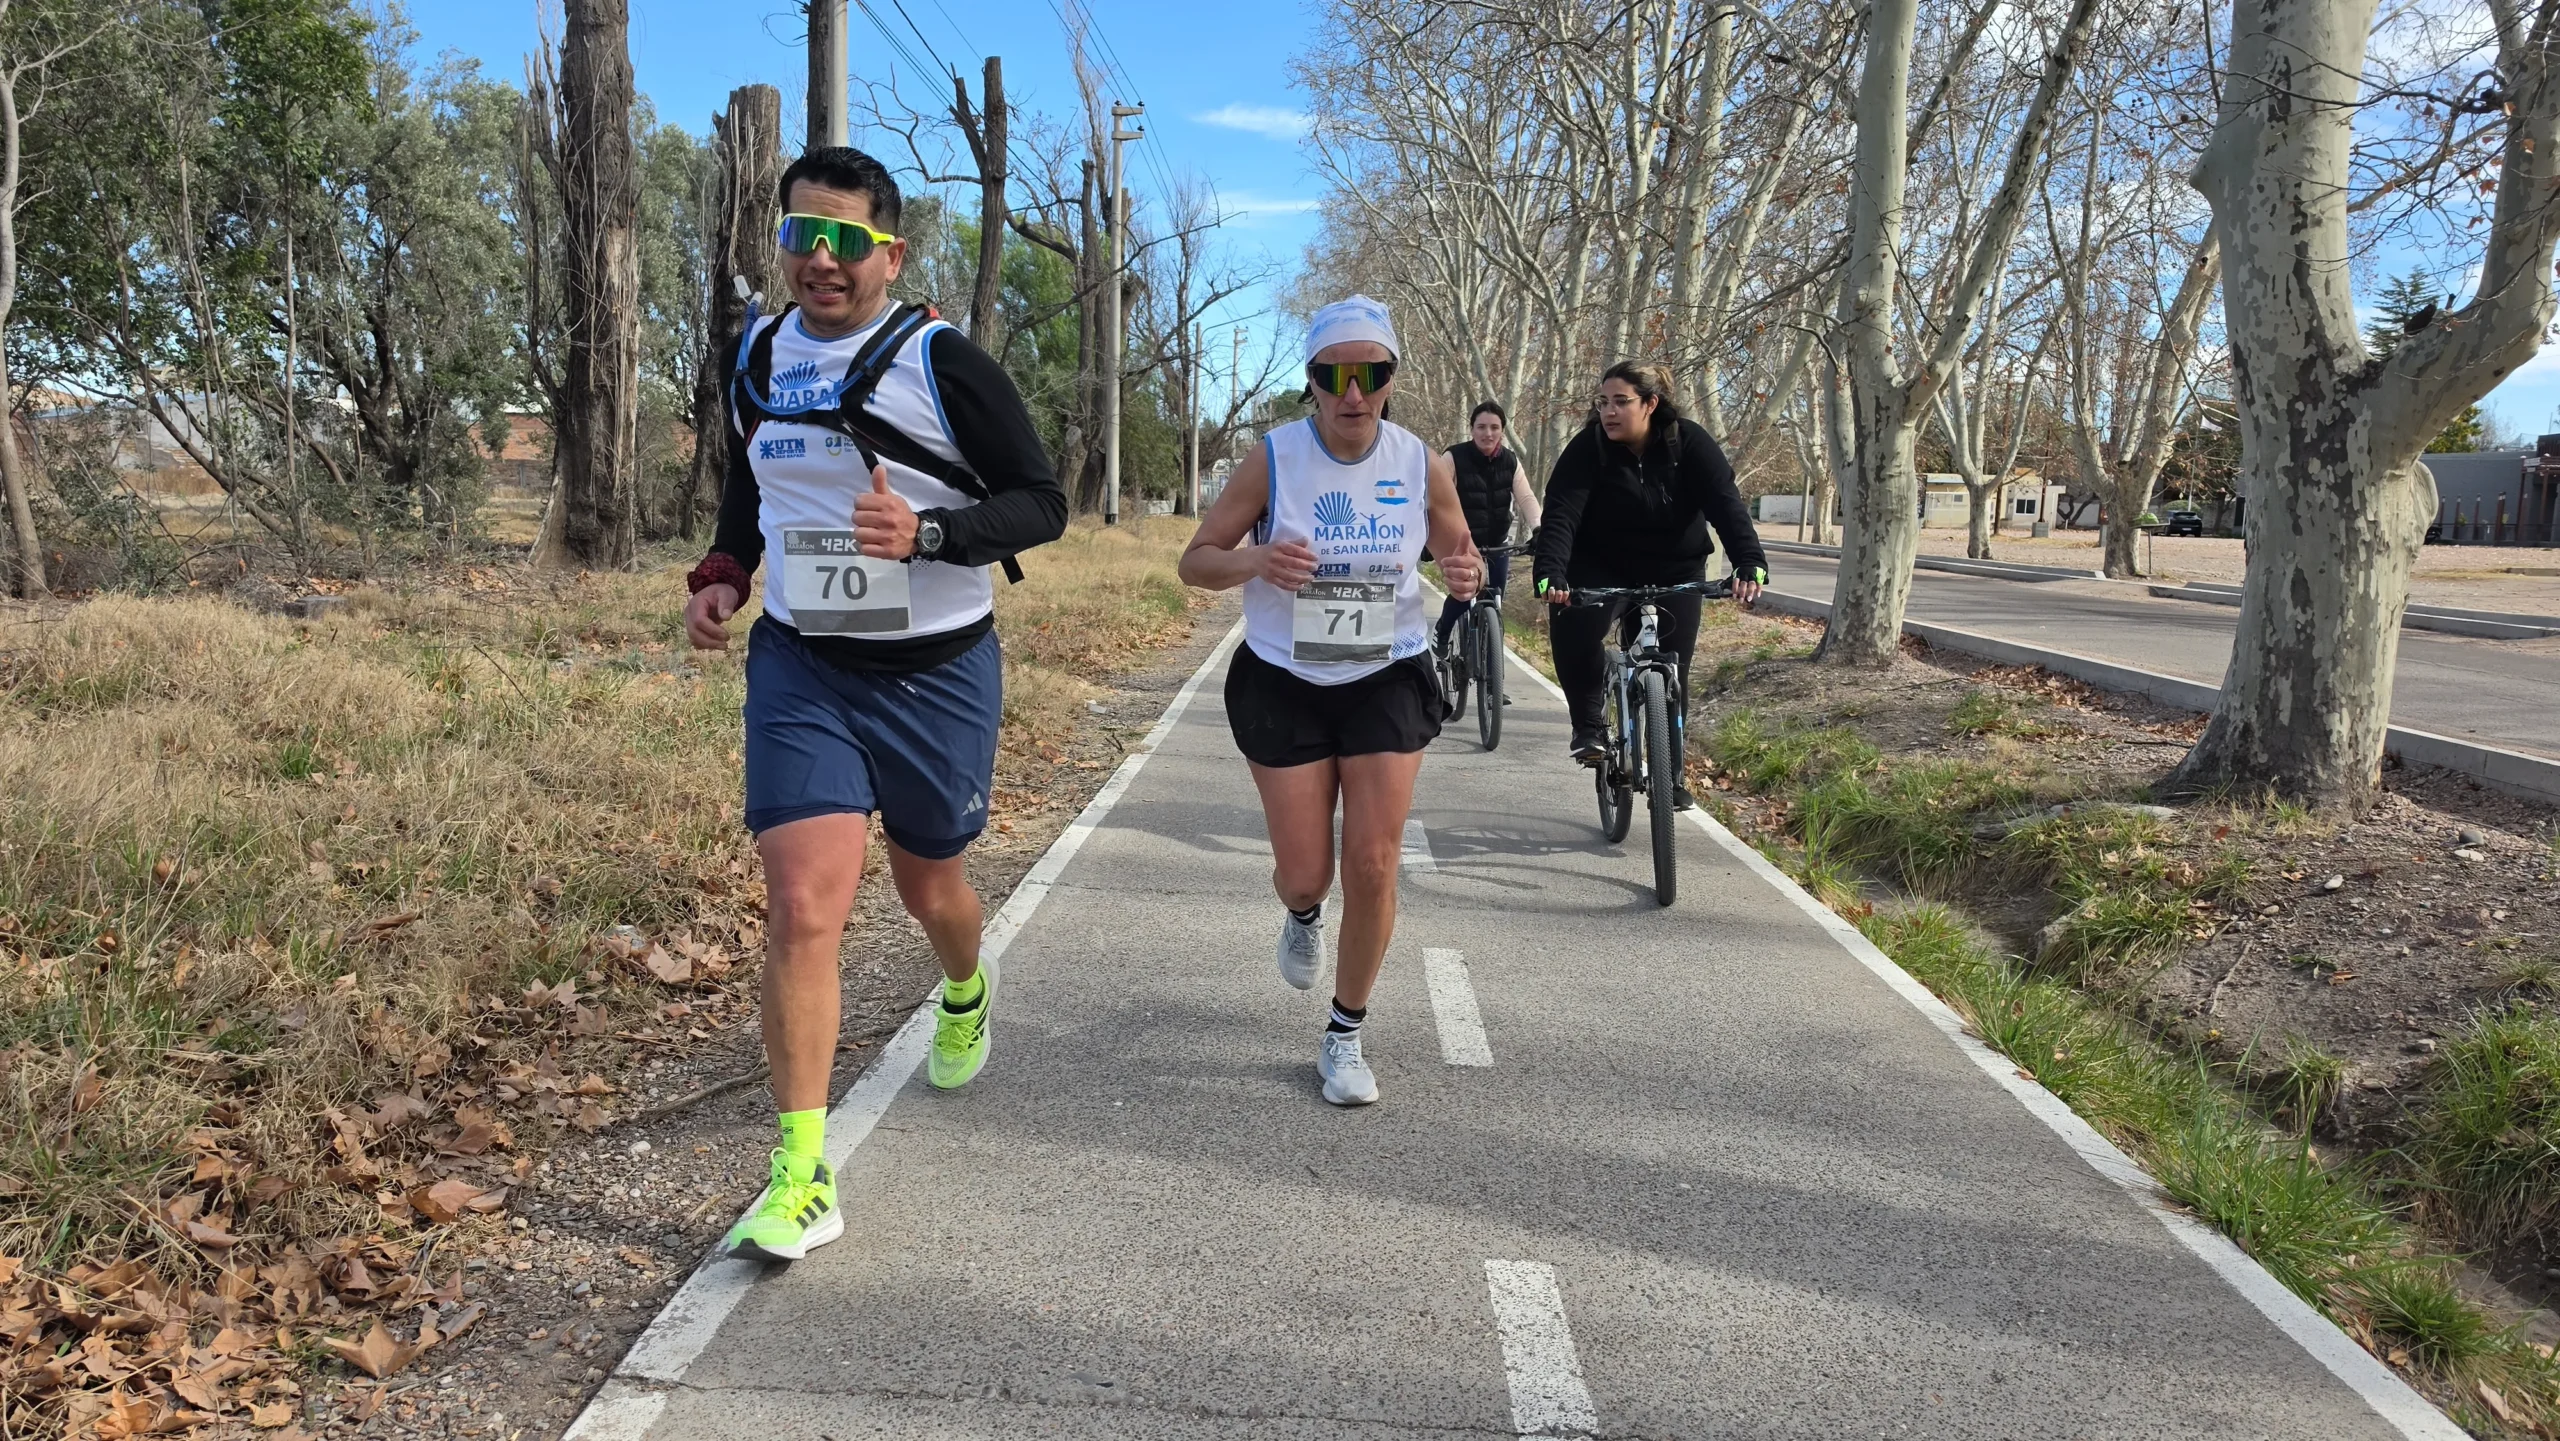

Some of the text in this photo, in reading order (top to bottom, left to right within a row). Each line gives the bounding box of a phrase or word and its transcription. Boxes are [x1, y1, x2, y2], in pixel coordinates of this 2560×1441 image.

[774, 438, 806, 449] UTN
[821, 538, 858, 552] 42K
[1333, 545, 1359, 555] SAN
[1361, 543, 1402, 554] RAFAEL
[1323, 562, 1351, 572] UTN
[815, 565, 868, 600] 70
[1332, 586, 1365, 599] 42K
[1324, 608, 1364, 637] 71
